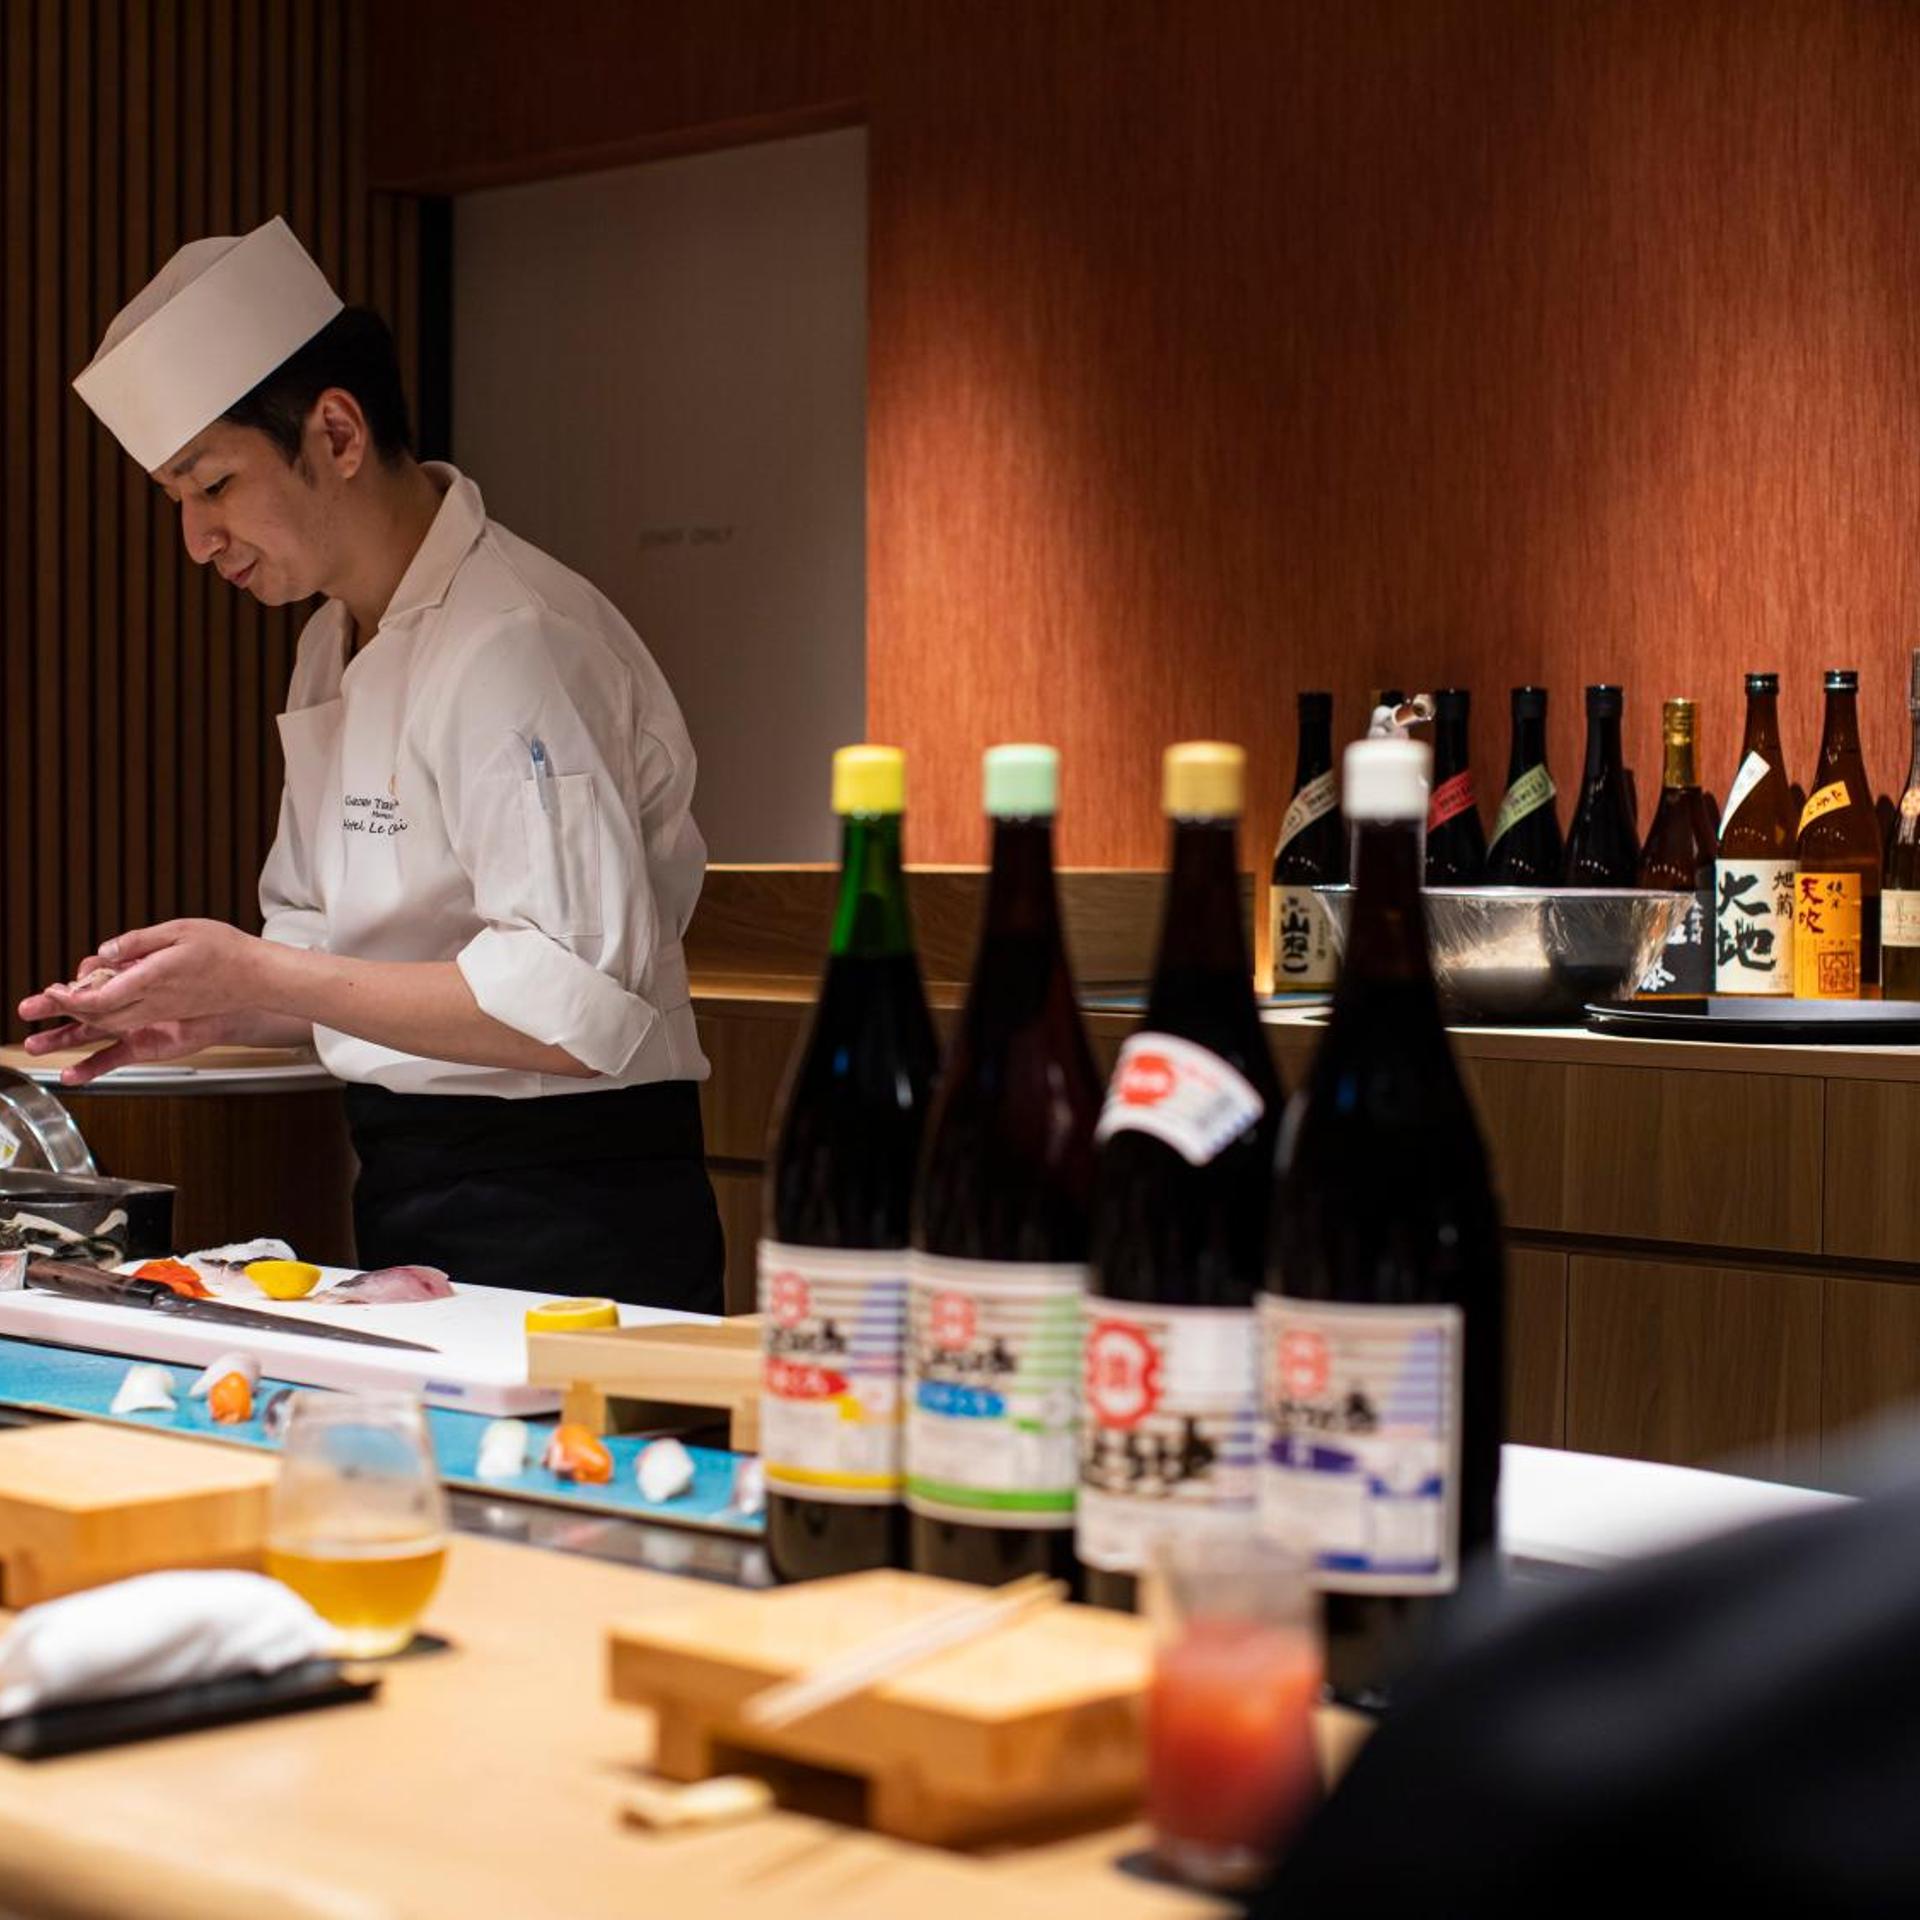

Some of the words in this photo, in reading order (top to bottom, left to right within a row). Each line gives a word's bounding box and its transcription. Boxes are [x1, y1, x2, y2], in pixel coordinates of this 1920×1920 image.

[1717, 871, 1777, 971] 大地
[1798, 877, 1825, 935] 天吹
[1281, 911, 1310, 974] 山ねこ
